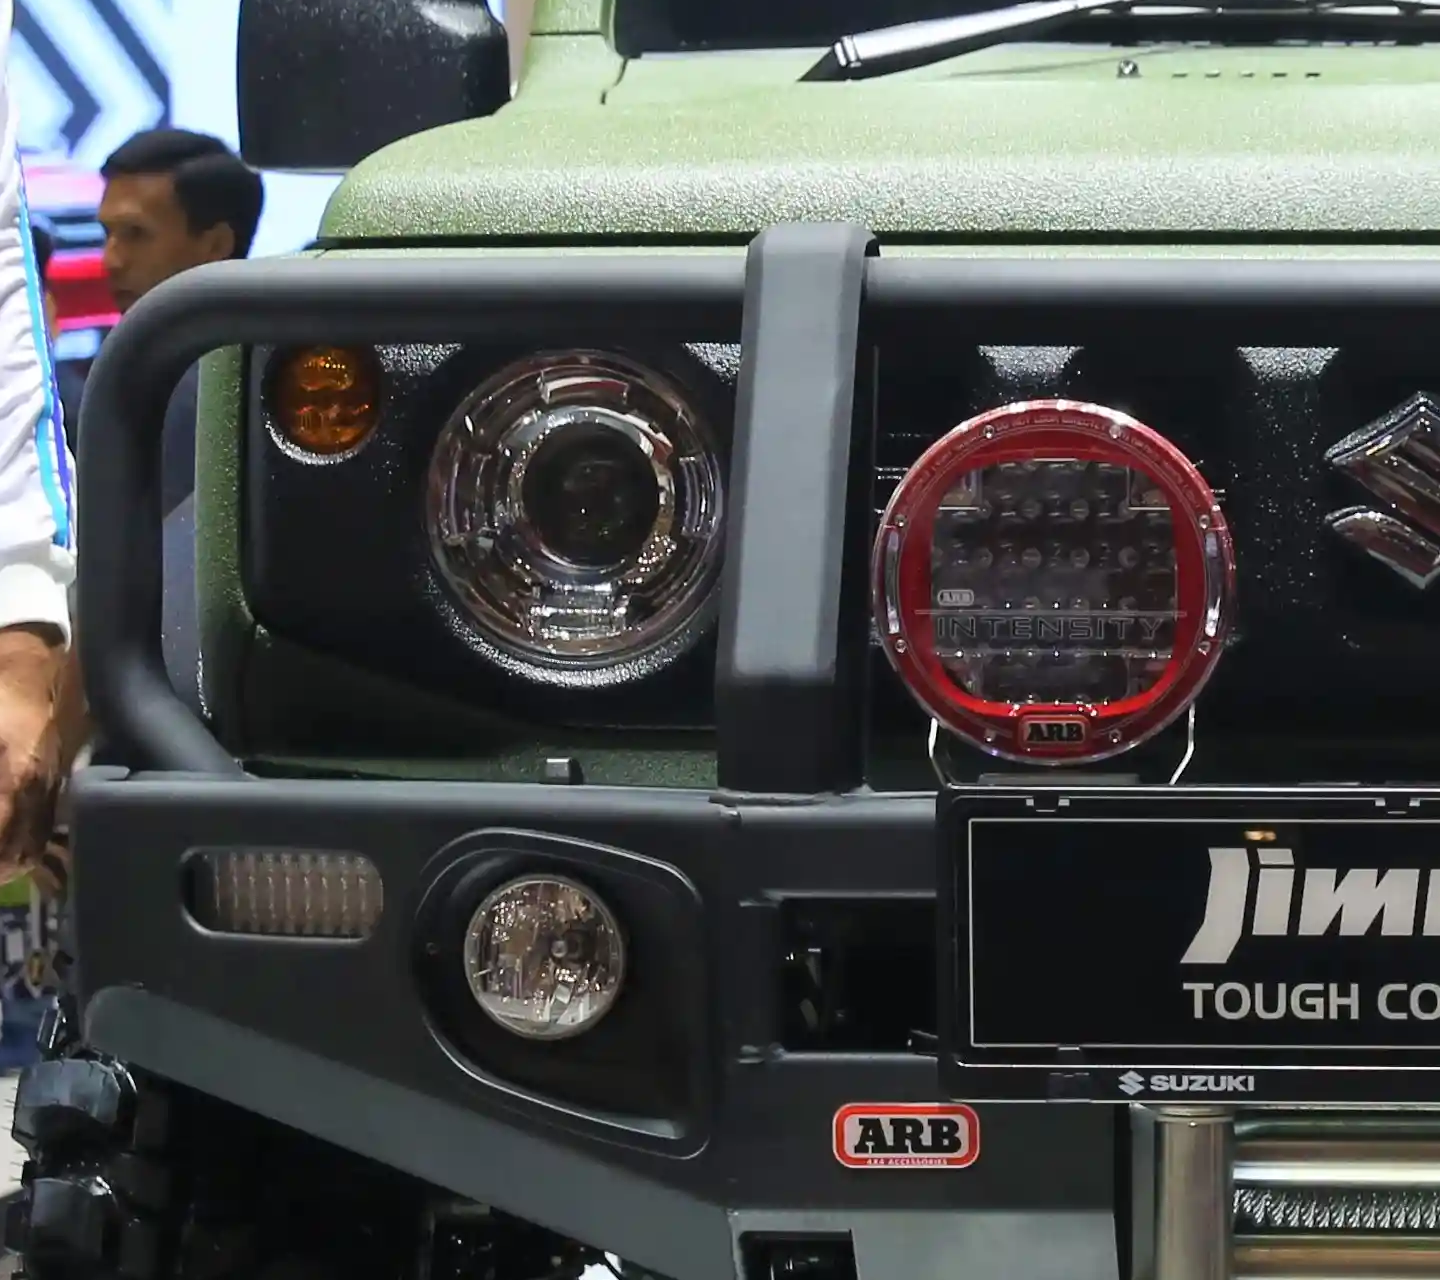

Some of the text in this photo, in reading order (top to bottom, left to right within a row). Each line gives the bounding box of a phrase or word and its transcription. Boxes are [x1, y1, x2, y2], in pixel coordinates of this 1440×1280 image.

[936, 615, 1163, 641] INTENSITY
[1025, 723, 1083, 742] ARB
[1182, 982, 1359, 1021] TOUGH
[1149, 1074, 1256, 1092] SUZUKI
[853, 1117, 963, 1154] ARB
